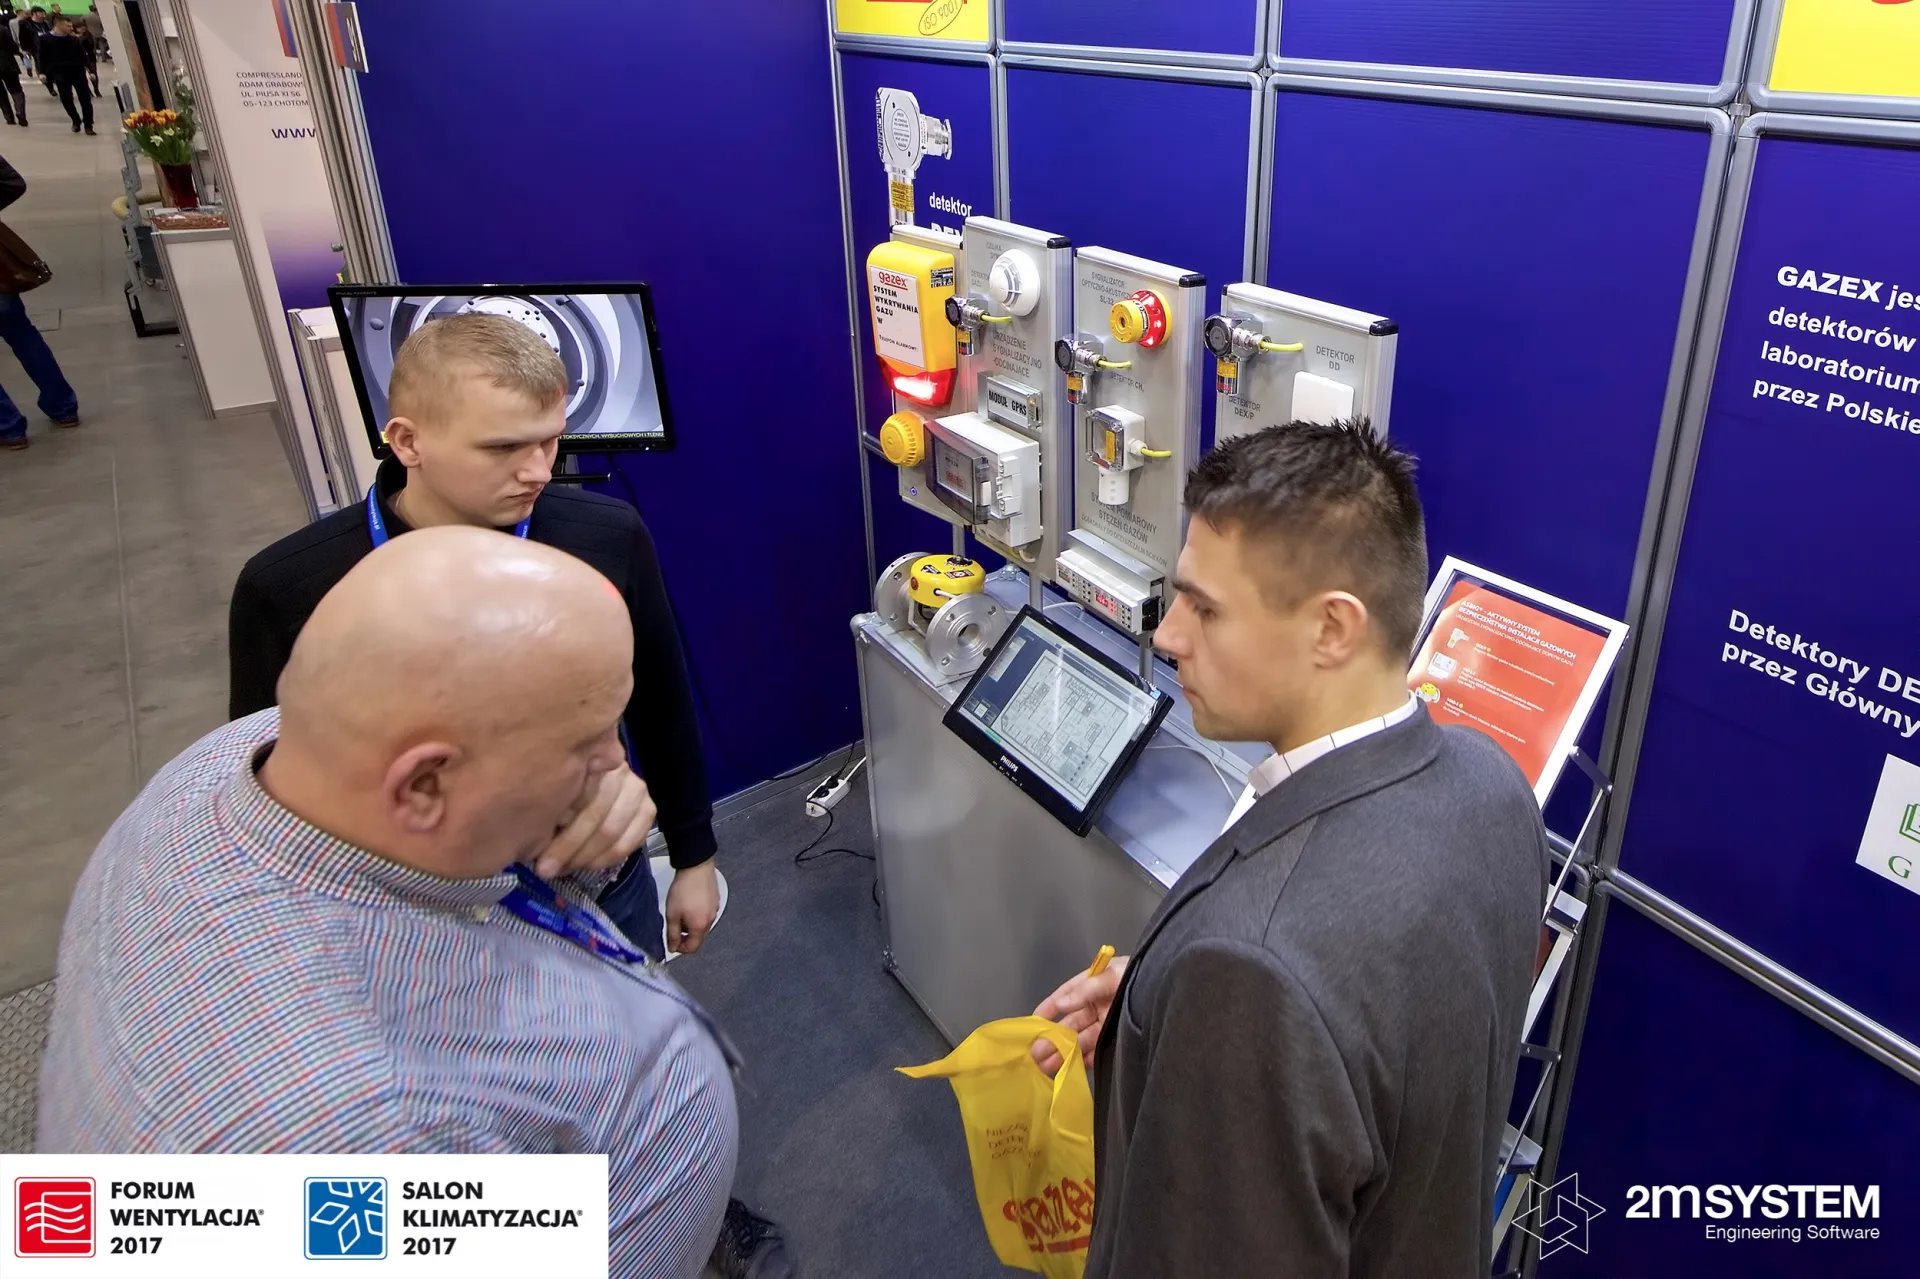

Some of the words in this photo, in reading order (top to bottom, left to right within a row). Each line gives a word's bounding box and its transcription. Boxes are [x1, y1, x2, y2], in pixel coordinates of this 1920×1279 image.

[923, 12, 937, 31] ISO
[929, 192, 972, 217] detektor
[878, 271, 907, 288] gazex
[1777, 266, 1884, 303] GAZEX
[873, 285, 897, 297] SYSTEM
[874, 295, 919, 314] WYKRYWANIA
[876, 306, 894, 316] GAZU
[1768, 306, 1917, 353] detektorów
[1316, 345, 1355, 364] DETEKTOR
[1328, 360, 1341, 371] DD
[1011, 400, 1027, 416] GPRS
[1228, 395, 1261, 412] DETEKTOR
[1752, 379, 1820, 409] przez
[1826, 392, 1920, 435] Polskie
[1516, 622, 1541, 636] SYSTEM
[1540, 640, 1577, 660] GAZOWYCH
[1728, 609, 1870, 684] Detektory
[1721, 642, 1797, 686] przez
[1805, 672, 1920, 738] Główny
[1000, 755, 1018, 772] PHILIPS
[1888, 855, 1912, 880] G
